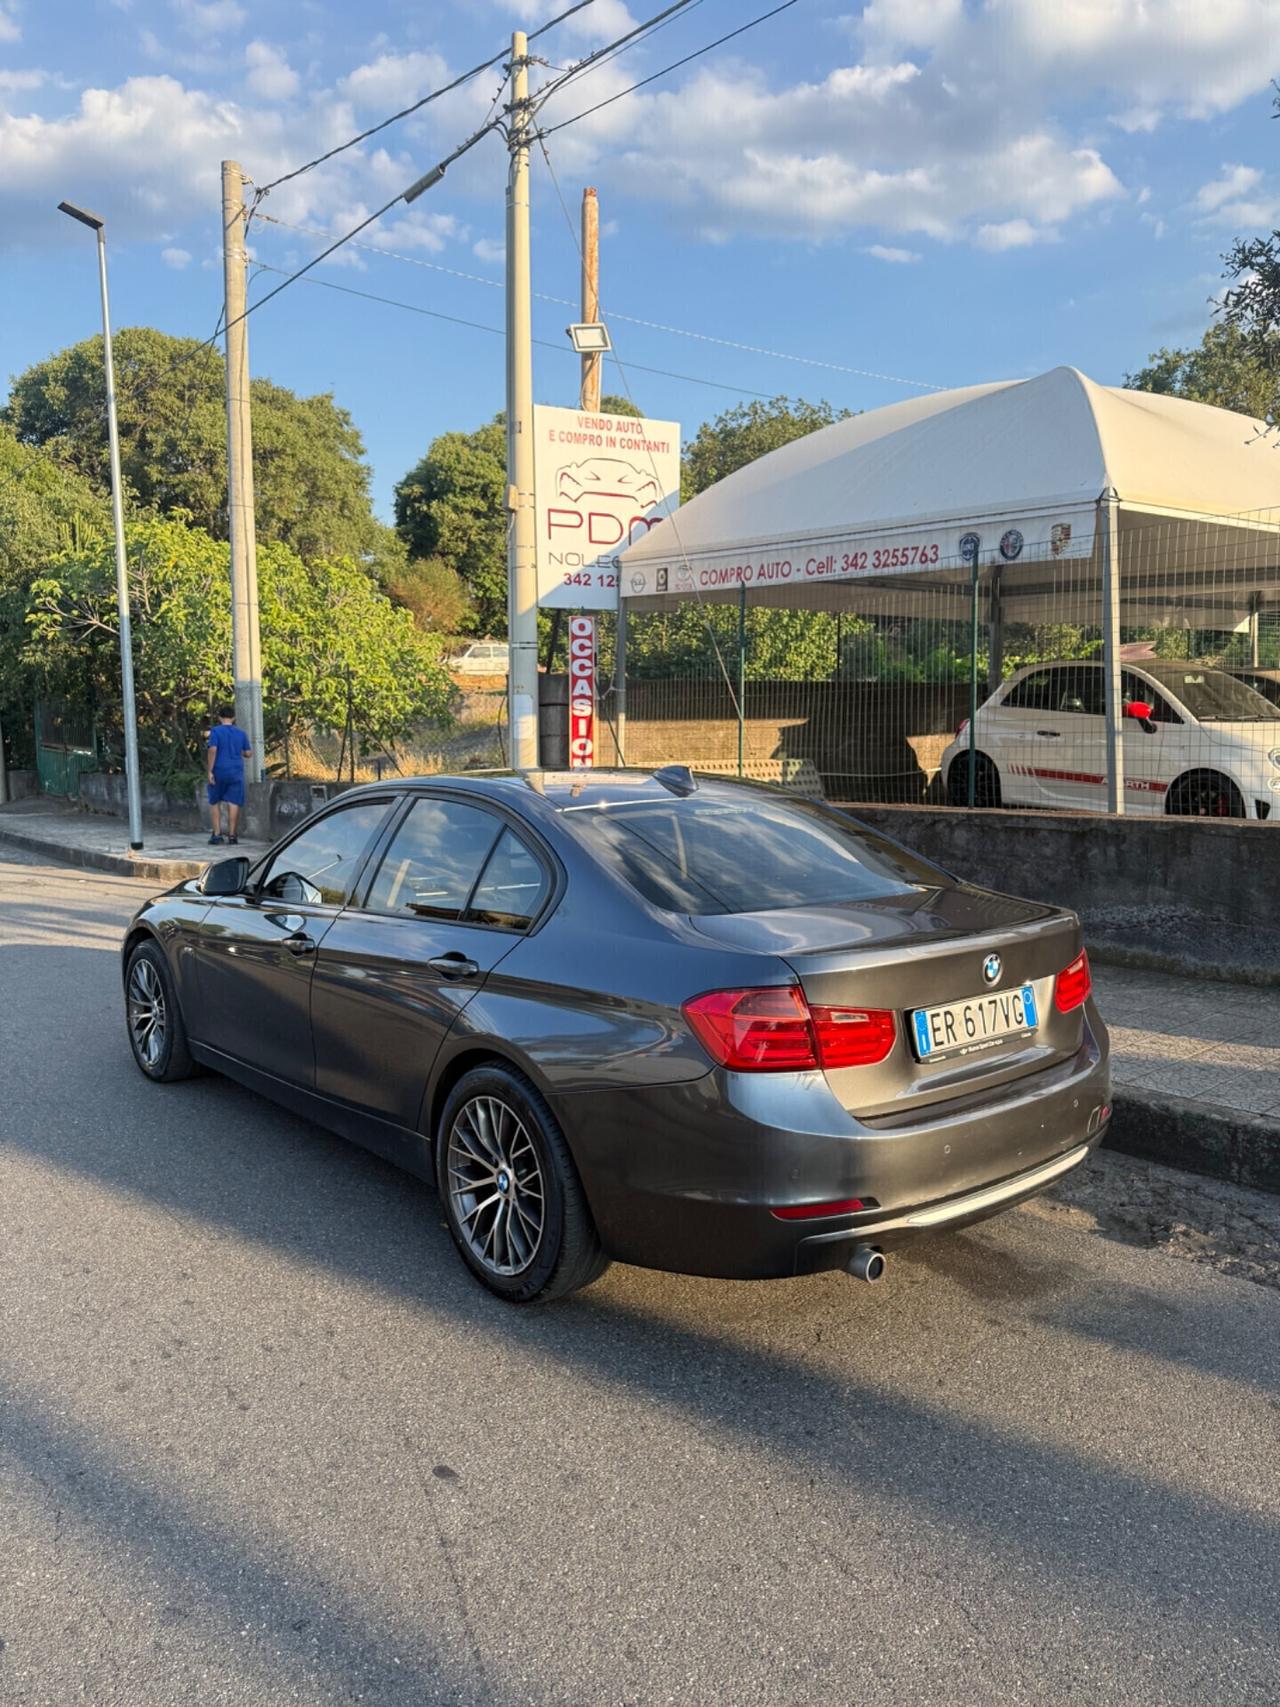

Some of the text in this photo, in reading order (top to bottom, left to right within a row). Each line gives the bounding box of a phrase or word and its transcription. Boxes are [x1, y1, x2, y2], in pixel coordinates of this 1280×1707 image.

[577, 415, 643, 434] VENDO AUTO
[549, 430, 670, 454] E COMPRO IN CONTANTI
[700, 564, 753, 586] COMPRO
[757, 561, 792, 580] AUTO
[805, 556, 837, 576] Cell:
[841, 552, 868, 572] 342
[872, 544, 940, 569] 3255763
[563, 573, 592, 587] 342
[930, 1010, 957, 1047] ER
[963, 994, 1024, 1038] 617VG
